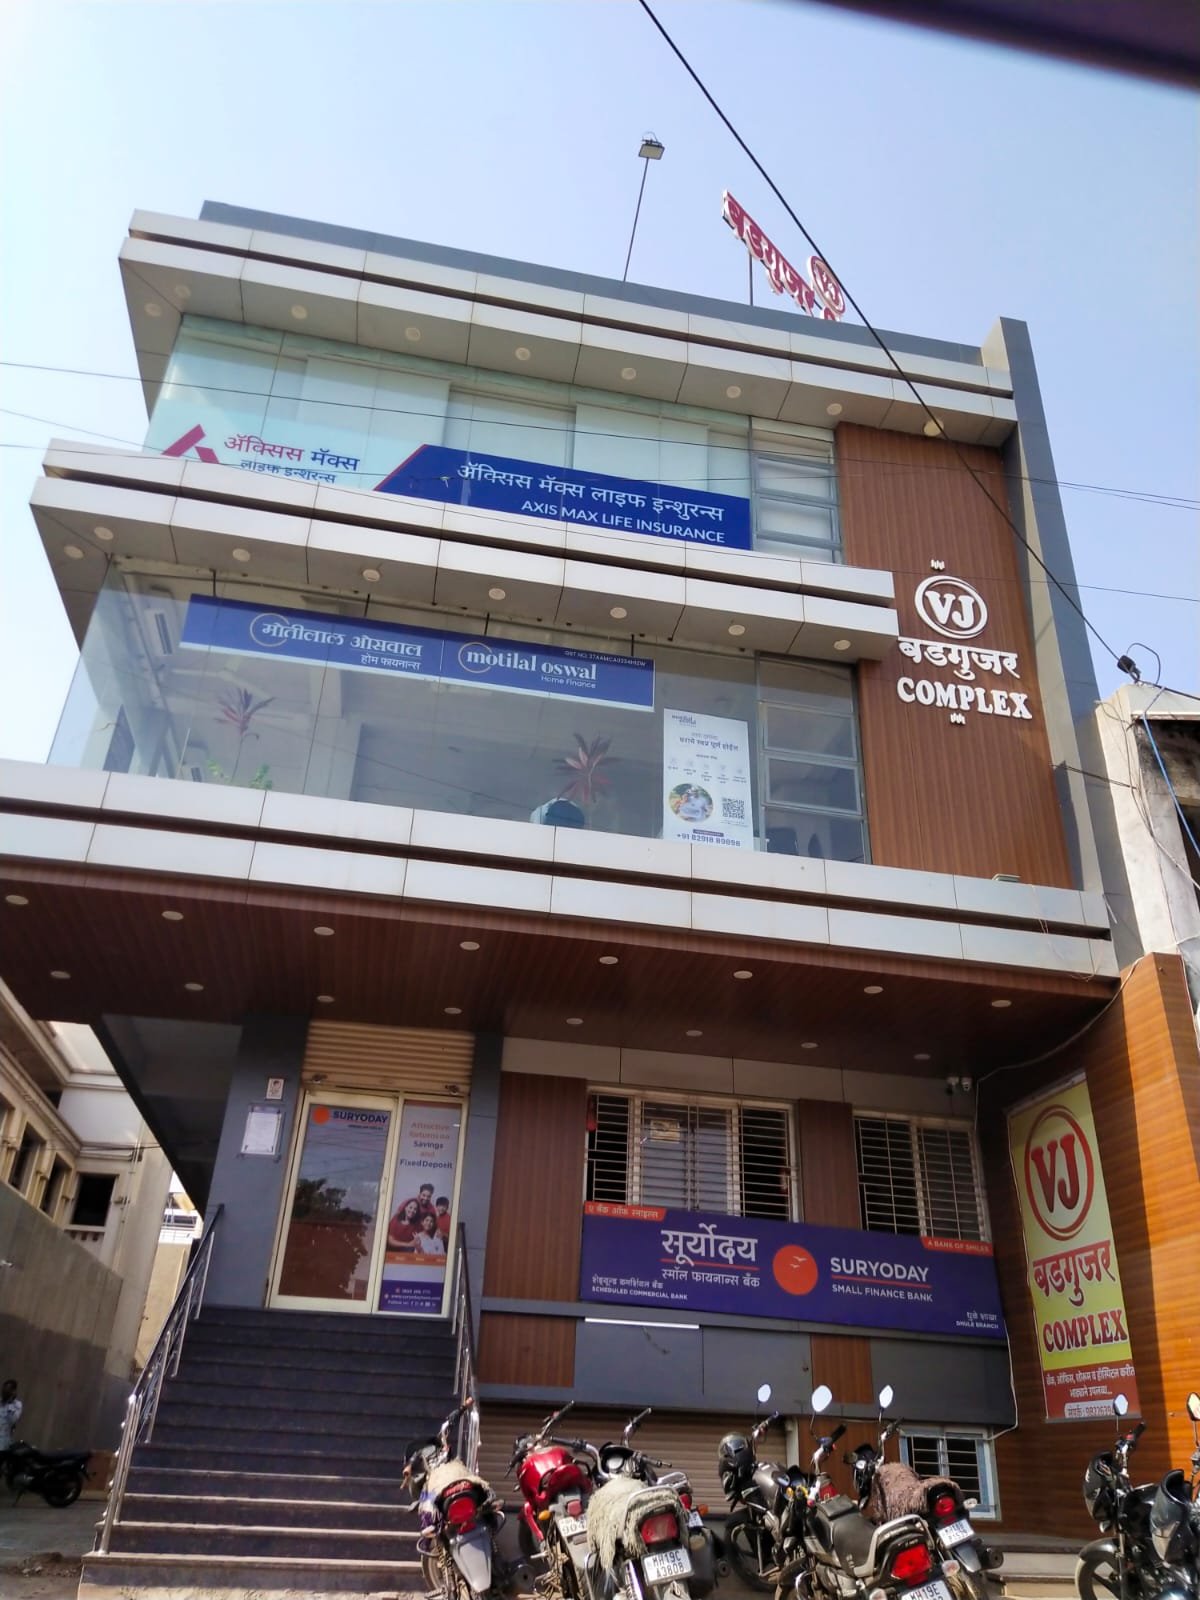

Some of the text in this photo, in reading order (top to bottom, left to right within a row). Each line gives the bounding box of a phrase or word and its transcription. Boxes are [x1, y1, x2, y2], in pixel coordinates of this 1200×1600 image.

[592, 487, 646, 509] लाइफ
[521, 500, 726, 543] AXIS MAX LIFE INSURANCE
[924, 590, 975, 629] VJ
[261, 622, 423, 657] मोतीलाल ओसवाल
[361, 653, 379, 665] होम
[467, 649, 597, 681] motilal oswal
[898, 636, 1021, 681] बडगुजर
[541, 675, 597, 689] Home Finance
[897, 676, 1033, 719] COMPLEX
[332, 1110, 388, 1124] SURYODAY
[1031, 1133, 1080, 1214] VJ
[660, 1223, 758, 1266] सूर्योदय
[661, 1266, 689, 1281] स्मॉल
[742, 1272, 760, 1288] बँक
[830, 1256, 929, 1282] SURYODAY
[1033, 1240, 1116, 1307] बडगुजर
[592, 1285, 688, 1300] SCHEDULED COMMERCIAL BANK
[831, 1283, 933, 1303] SMALL FINANCE BANK
[1043, 1309, 1128, 1353] COMPLEX
